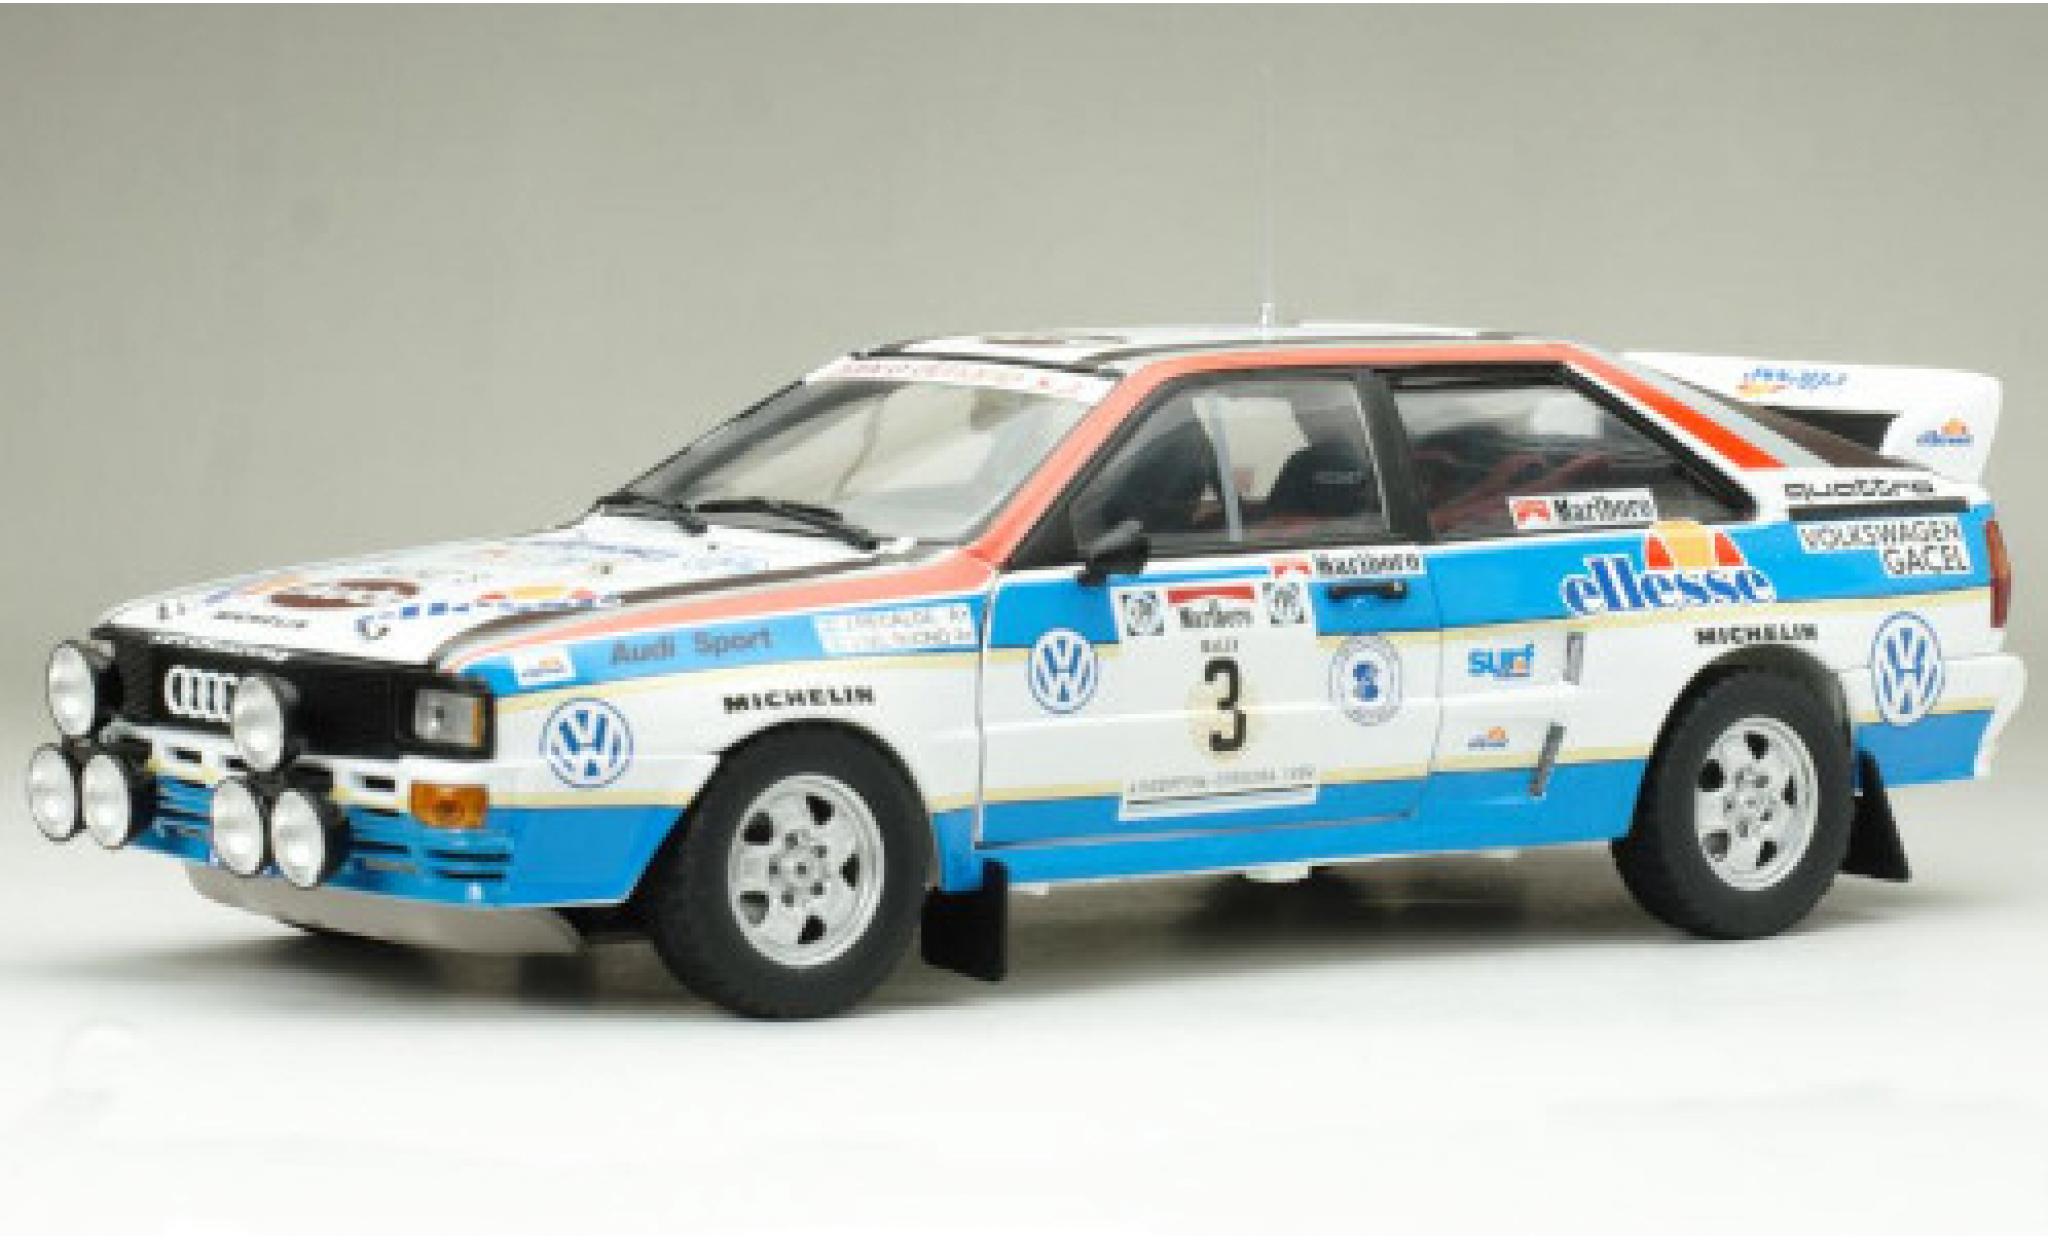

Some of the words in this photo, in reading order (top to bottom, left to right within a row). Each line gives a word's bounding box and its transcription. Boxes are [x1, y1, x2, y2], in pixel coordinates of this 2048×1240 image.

[1784, 478, 1934, 500] quattro
[1554, 497, 1654, 523] Marlboro
[1801, 520, 1960, 551] VOLKSWAGEN
[1884, 543, 1968, 575] GACEL
[1563, 555, 1771, 616] ellesse
[611, 633, 676, 667] Audi
[694, 627, 773, 658] Sport
[1695, 621, 1820, 646] MICHELIN
[722, 685, 875, 714] MICHELIN
[1203, 656, 1247, 753] 3
